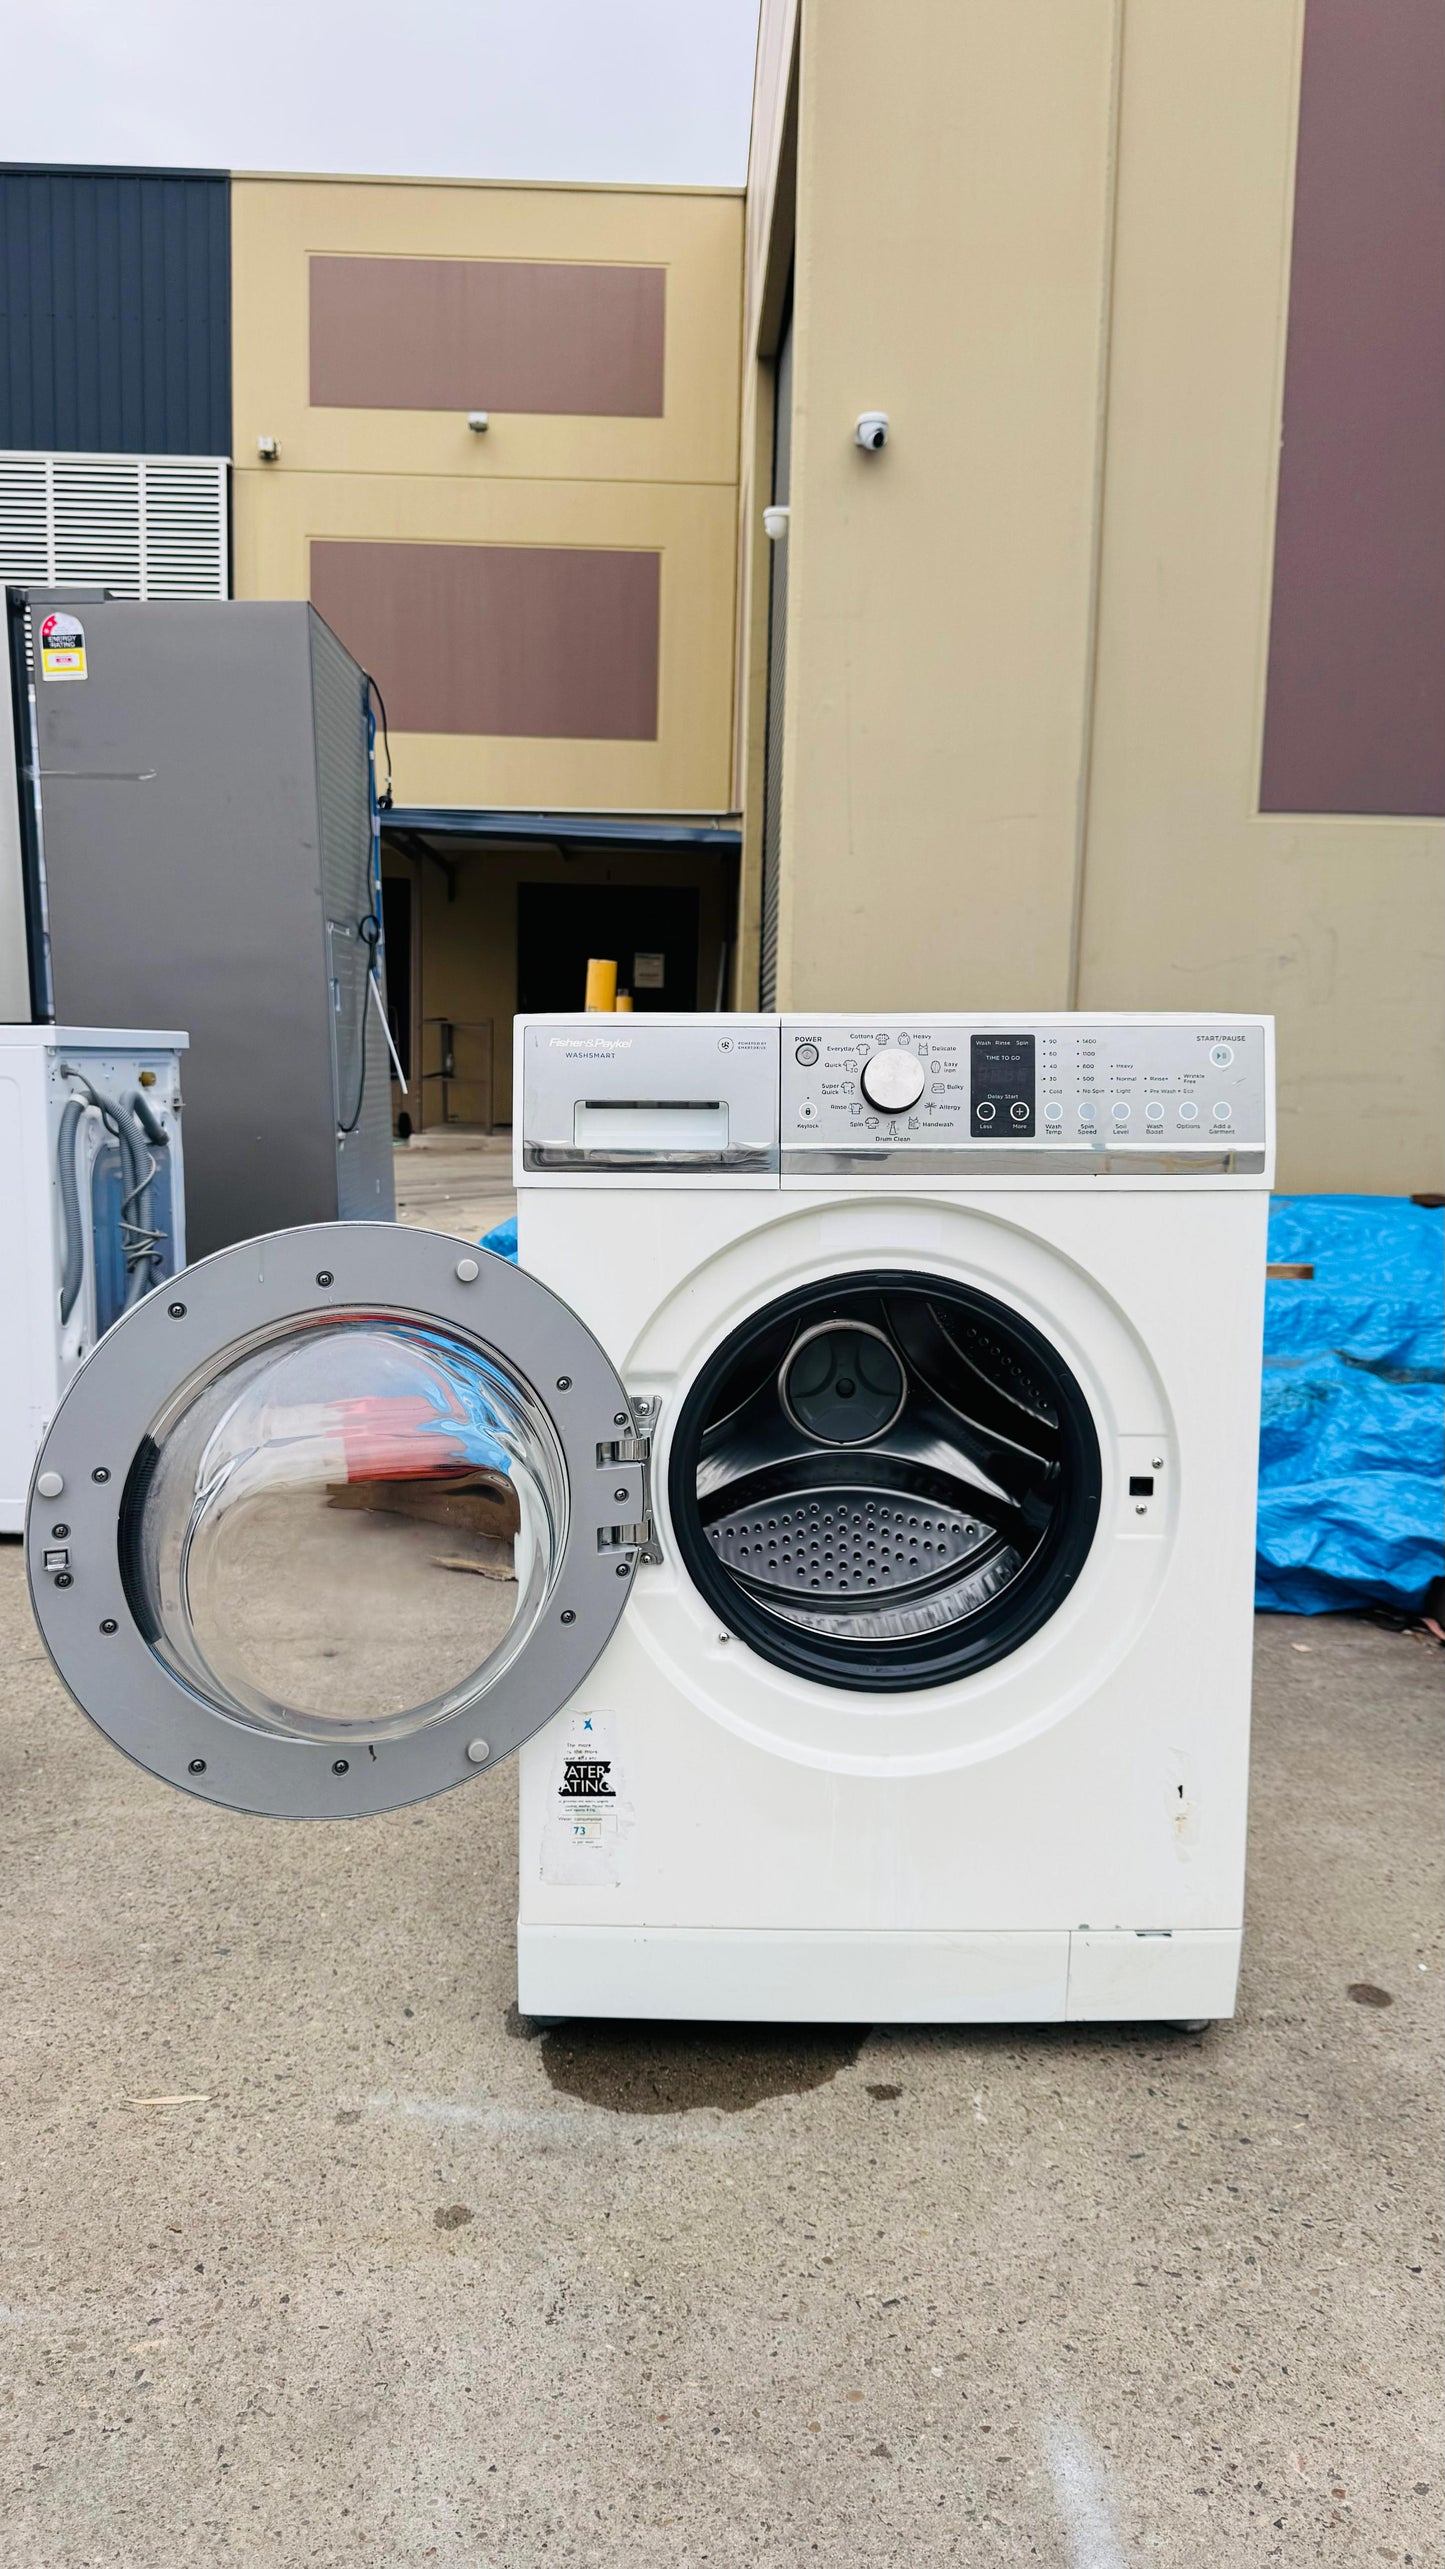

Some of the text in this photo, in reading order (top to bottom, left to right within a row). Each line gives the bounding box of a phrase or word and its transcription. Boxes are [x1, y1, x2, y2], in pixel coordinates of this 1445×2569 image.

[548, 1038, 633, 1050] Fisher&Paykel
[566, 1765, 605, 1779] ATER
[560, 1780, 610, 1793] ATING
[573, 1826, 586, 1835] 73
